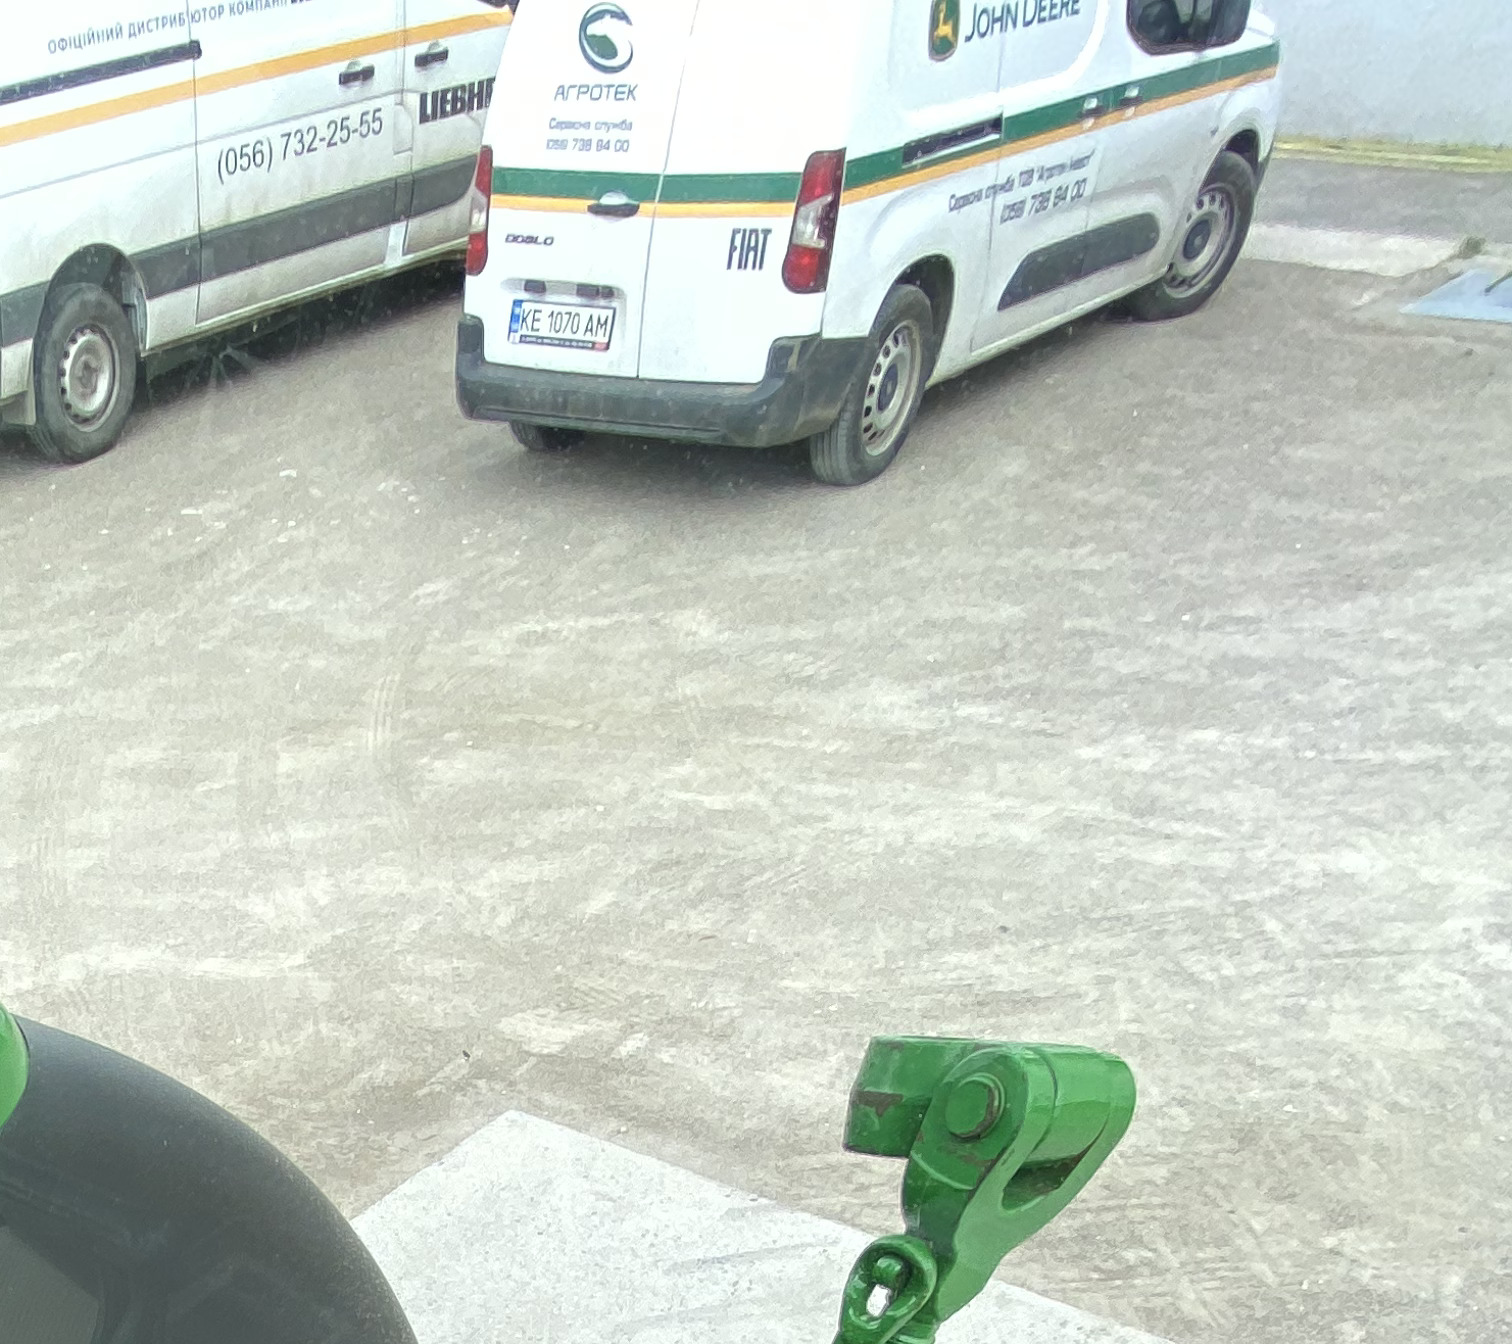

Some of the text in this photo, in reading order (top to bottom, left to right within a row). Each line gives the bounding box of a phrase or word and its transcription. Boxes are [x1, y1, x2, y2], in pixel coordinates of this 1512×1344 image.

[47, 22, 123, 54] ОФІЦІЙНИЙ
[964, 0, 1018, 42] JOHN
[554, 84, 638, 101] АГРОТЕК
[217, 107, 384, 182] (056) 732-25-55
[726, 228, 772, 271] FIAT
[520, 308, 609, 337] KE 1070 AM
